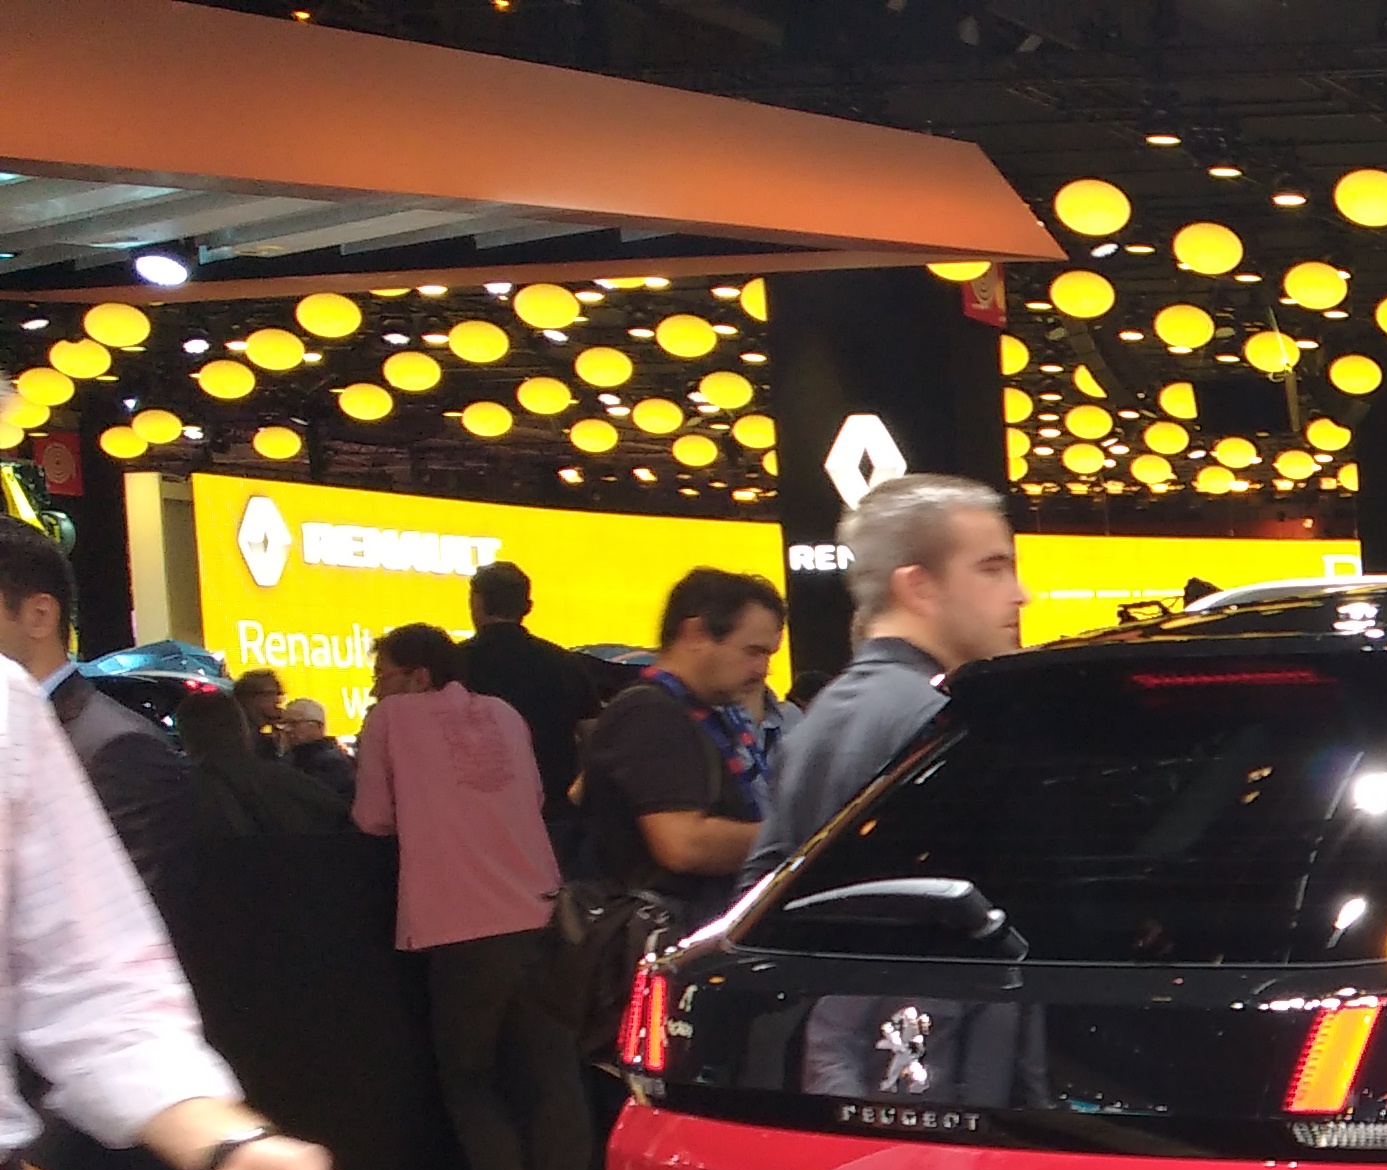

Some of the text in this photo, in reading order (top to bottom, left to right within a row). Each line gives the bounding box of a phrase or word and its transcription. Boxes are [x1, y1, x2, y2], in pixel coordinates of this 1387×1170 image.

[302, 521, 502, 576] RENAULT
[237, 619, 378, 669] Renault
[840, 1104, 980, 1132] PEUGEOT
